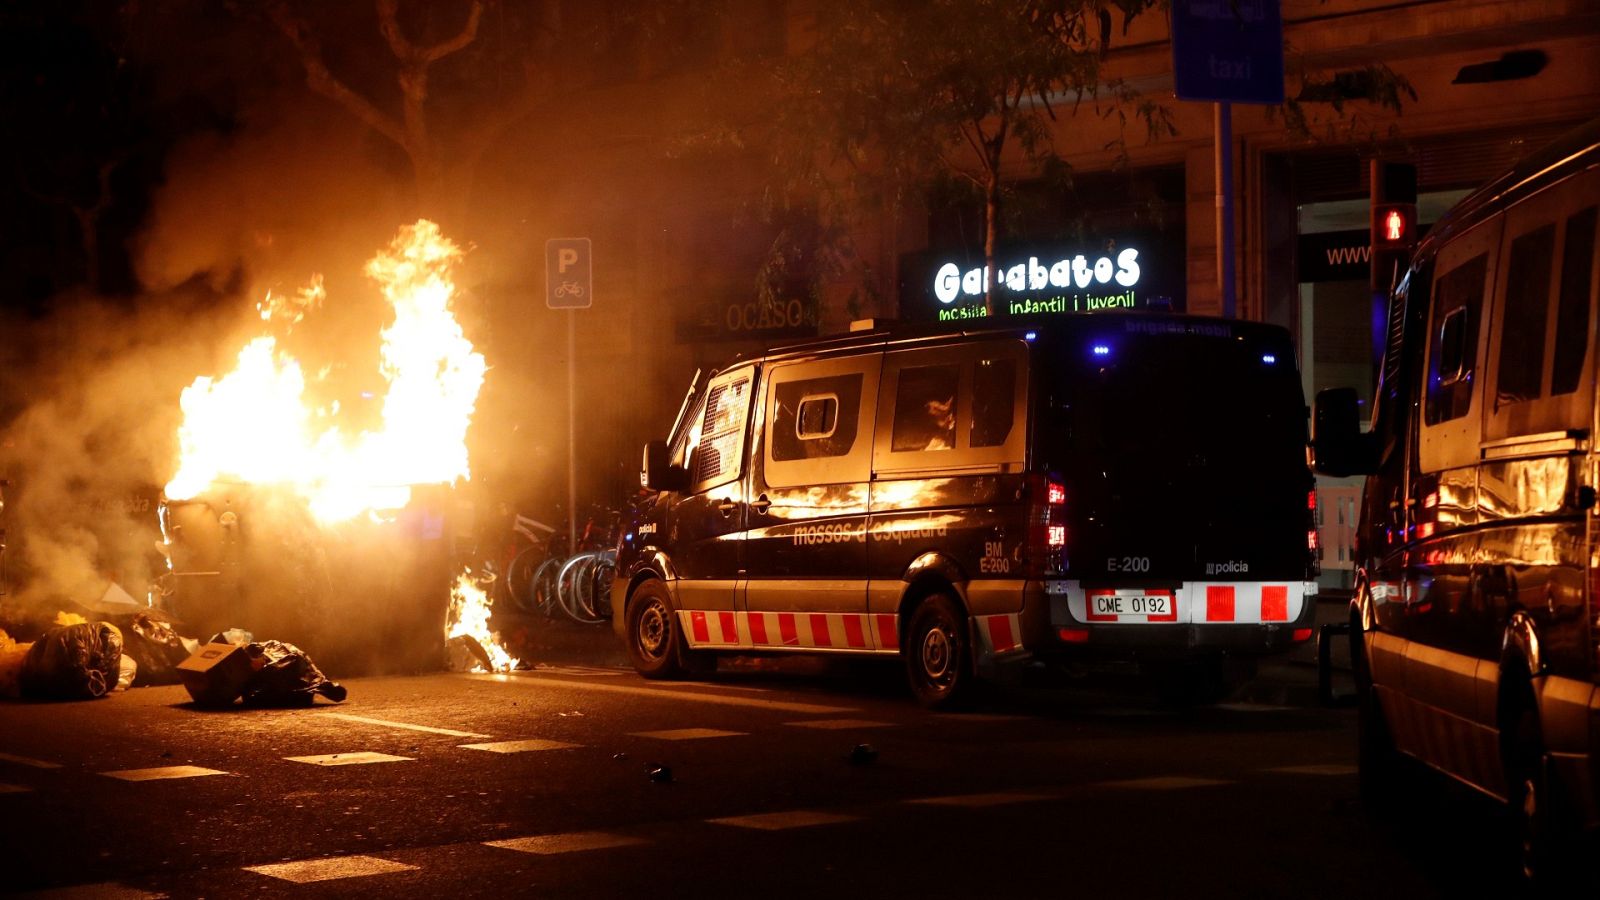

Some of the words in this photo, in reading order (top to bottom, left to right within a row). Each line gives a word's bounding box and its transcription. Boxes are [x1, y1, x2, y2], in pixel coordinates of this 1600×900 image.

[1208, 53, 1251, 79] taxi
[559, 248, 578, 273] P
[1010, 296, 1066, 315] infantil
[1074, 294, 1079, 312] i
[1086, 290, 1136, 312] juvenil
[726, 299, 803, 331] OCASO
[793, 522, 852, 546] mossos
[985, 541, 1003, 558] BM
[979, 558, 1010, 574] E-200
[1107, 556, 1150, 573] E-200
[1215, 560, 1249, 575] policia
[1097, 598, 1123, 613] CME
[1132, 598, 1165, 613] 0192
